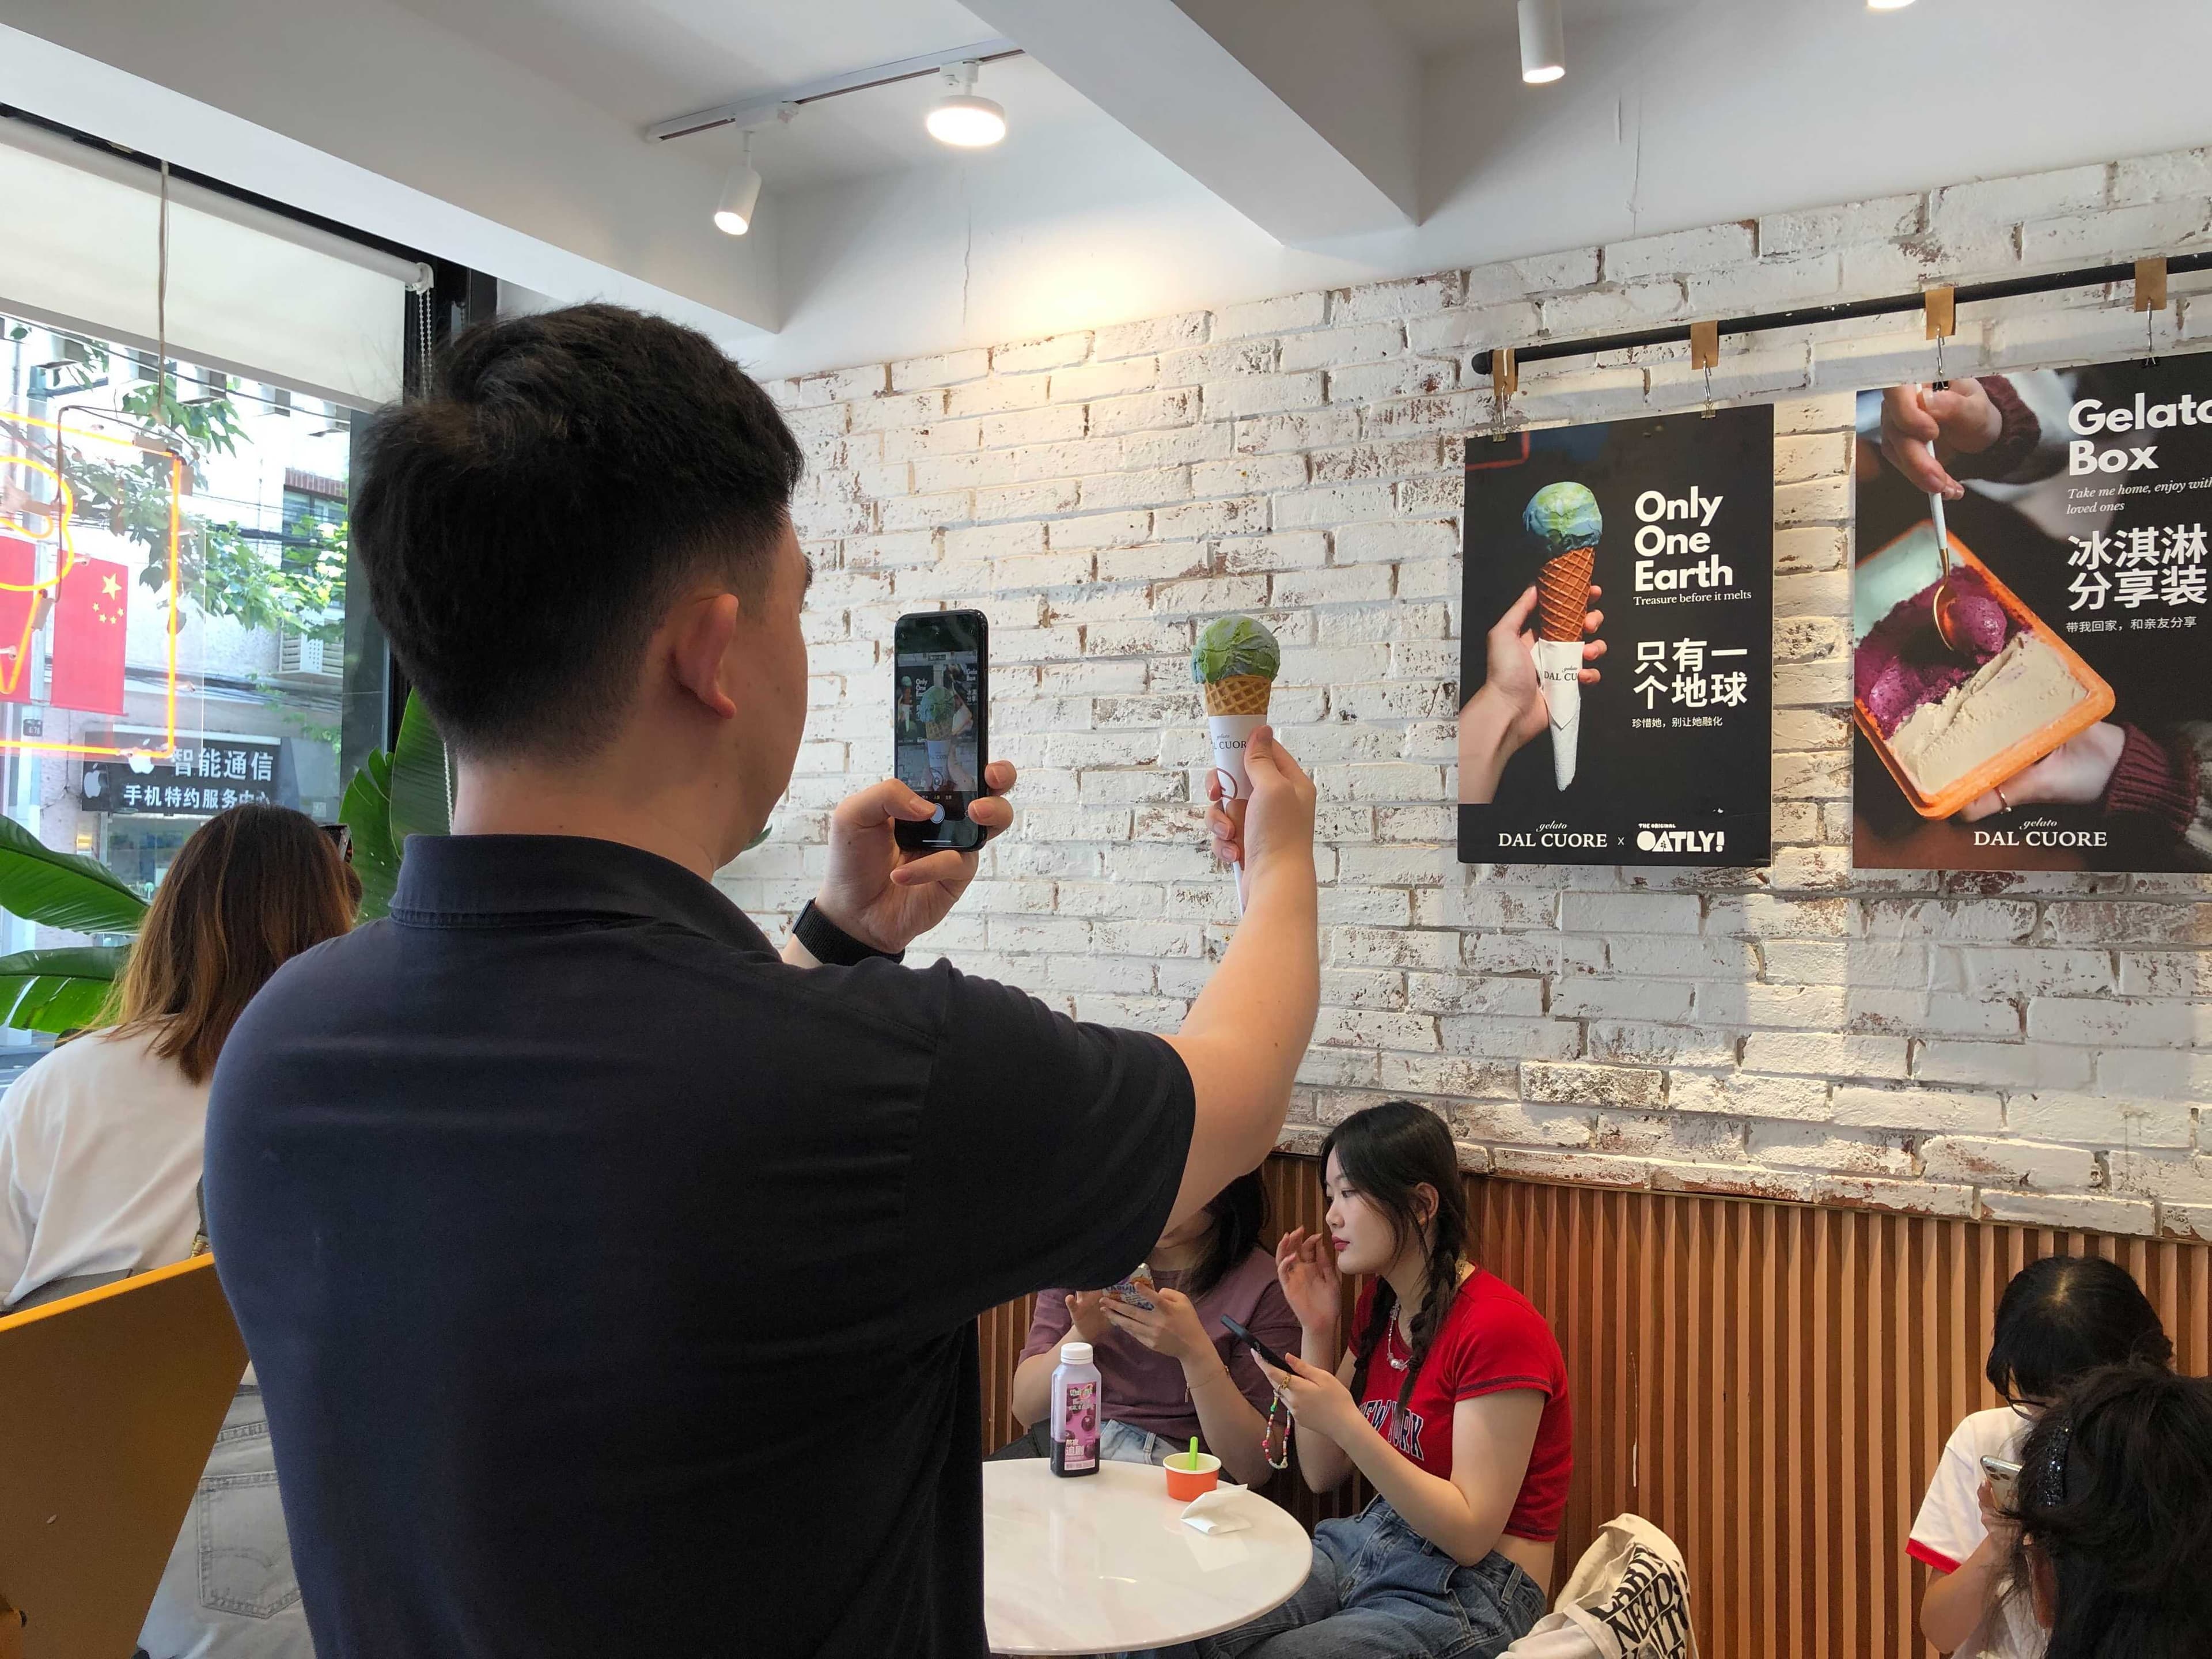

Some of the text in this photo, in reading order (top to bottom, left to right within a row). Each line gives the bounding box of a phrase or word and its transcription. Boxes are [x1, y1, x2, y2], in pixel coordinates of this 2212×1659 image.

[2069, 440, 2159, 476] Box
[2067, 487, 2096, 499] Take
[2099, 488, 2115, 497] me
[2118, 484, 2151, 495] home,
[2154, 480, 2186, 494] enjoy
[1635, 486, 1724, 527] Only
[2066, 502, 2125, 514] loved ones
[1634, 525, 1710, 557] One
[2067, 523, 2208, 570] 冰淇淋
[1635, 554, 1733, 592] Earth
[2067, 564, 2207, 611] 分享装
[1633, 590, 1752, 605] Treasure before it melts
[2066, 616, 2197, 634] 带我回家，和亲友分享
[1634, 637, 1748, 675] 只有一
[1544, 671, 1562, 681] DAL
[1633, 671, 1748, 710] 个地球
[1631, 716, 1723, 728] 珍惜她，别让她融化
[1219, 741, 1247, 749] CUOR
[172, 747, 274, 782] 智能通信
[1536, 820, 1567, 832] gelato
[2019, 817, 2058, 830] gelato
[1498, 833, 1608, 847] DAL CUORE
[1637, 831, 1725, 852] OATLY!
[1974, 831, 2108, 846] DAL CUORE
